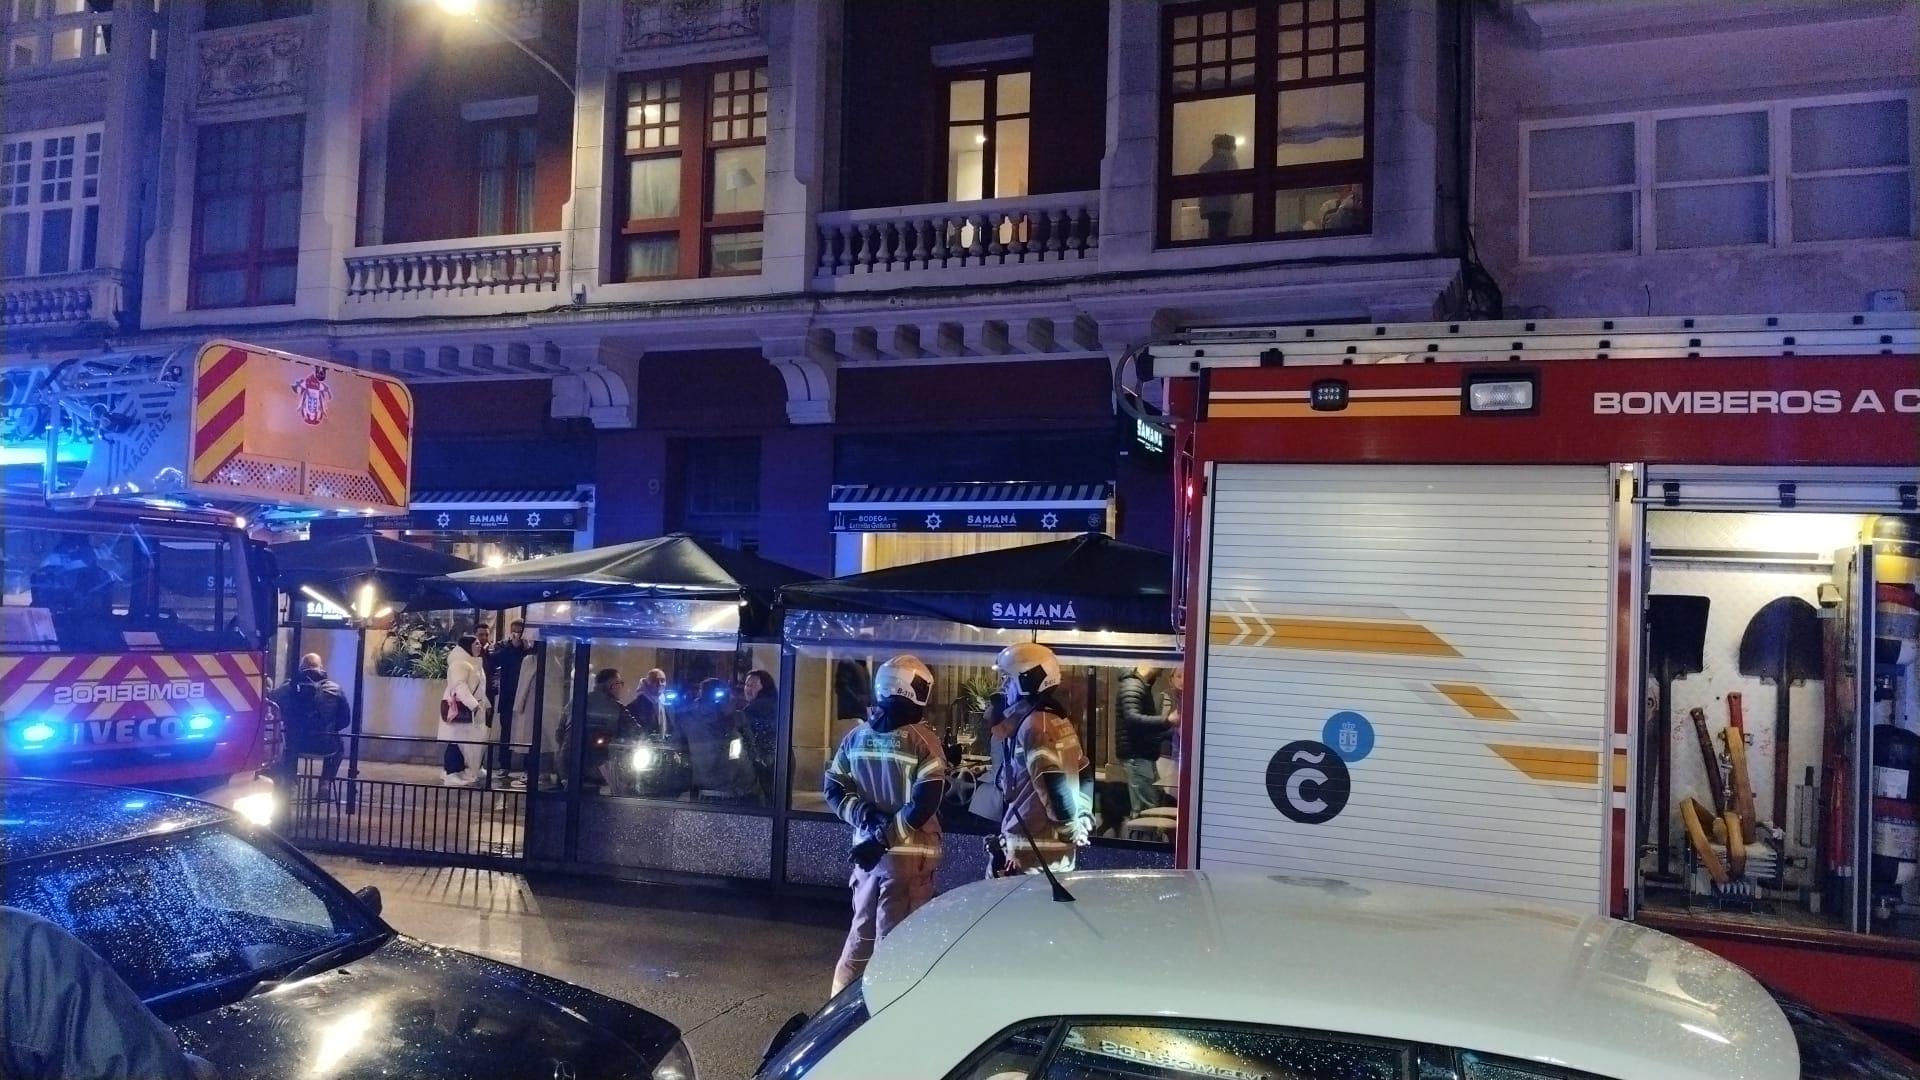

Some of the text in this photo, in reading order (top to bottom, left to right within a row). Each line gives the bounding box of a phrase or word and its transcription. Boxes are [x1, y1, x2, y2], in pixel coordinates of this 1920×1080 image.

[1593, 390, 1841, 414] BOMBEROS
[1850, 389, 1885, 413] A
[122, 409, 172, 476] MAGIRUS
[469, 512, 509, 523] SAMANÁ
[967, 512, 1017, 524] SAMANÁ
[992, 600, 1076, 619] SAMANÁ
[73, 717, 184, 744] IVECO
